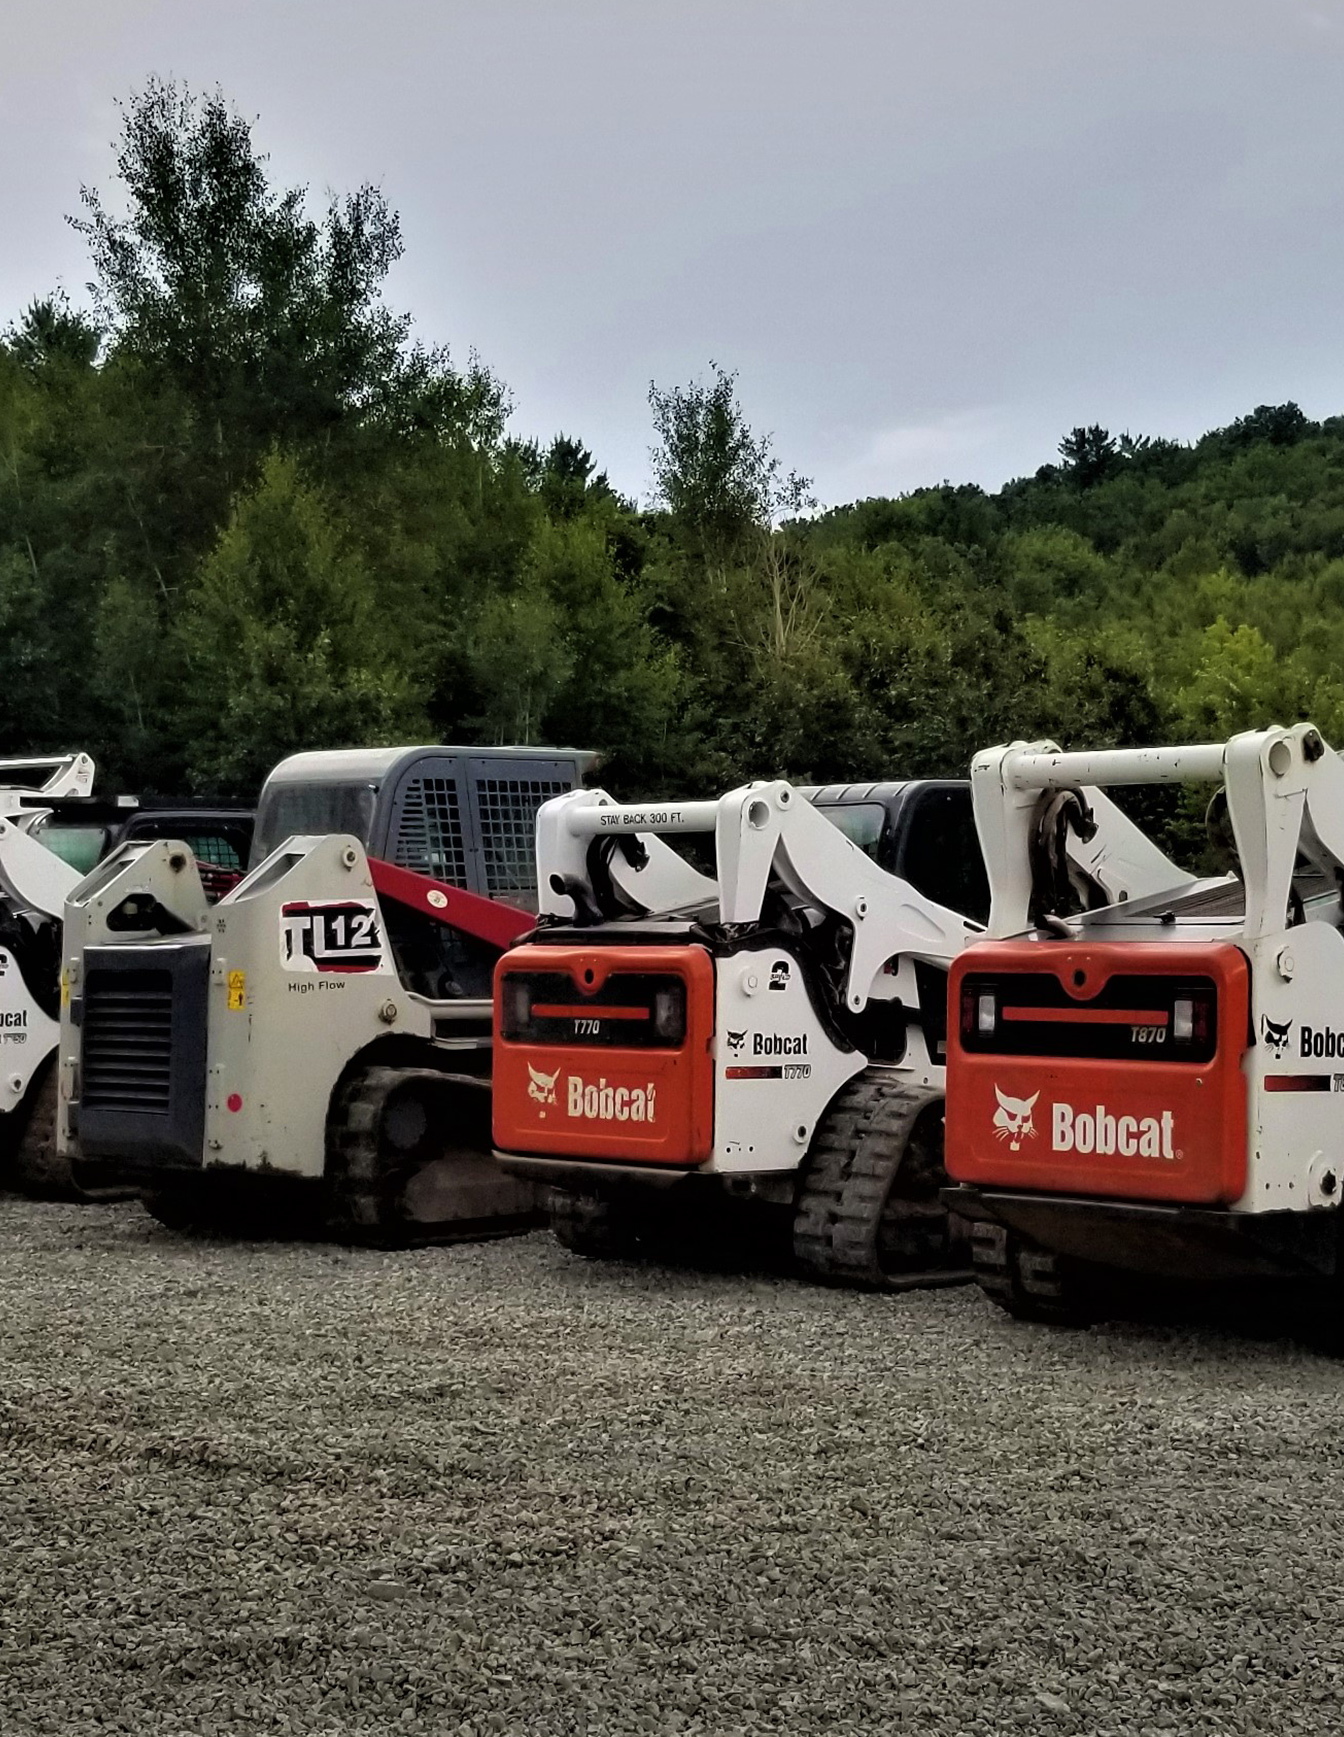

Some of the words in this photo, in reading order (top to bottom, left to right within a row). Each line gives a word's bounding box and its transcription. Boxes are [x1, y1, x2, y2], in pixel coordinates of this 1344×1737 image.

[600, 815, 620, 826] STAY
[623, 813, 647, 825] BACK
[650, 812, 667, 824] 300
[671, 812, 685, 823] FT.
[282, 913, 382, 959] TL12
[768, 960, 790, 991] 2
[288, 982, 315, 993] High
[318, 981, 346, 991] Flow
[574, 1019, 600, 1035] T770
[1131, 1026, 1166, 1043] T870
[753, 1032, 808, 1056] Bobcat
[784, 1064, 812, 1079] T770
[567, 1075, 656, 1123] Bobcat
[1052, 1102, 1175, 1160] Bobcat
